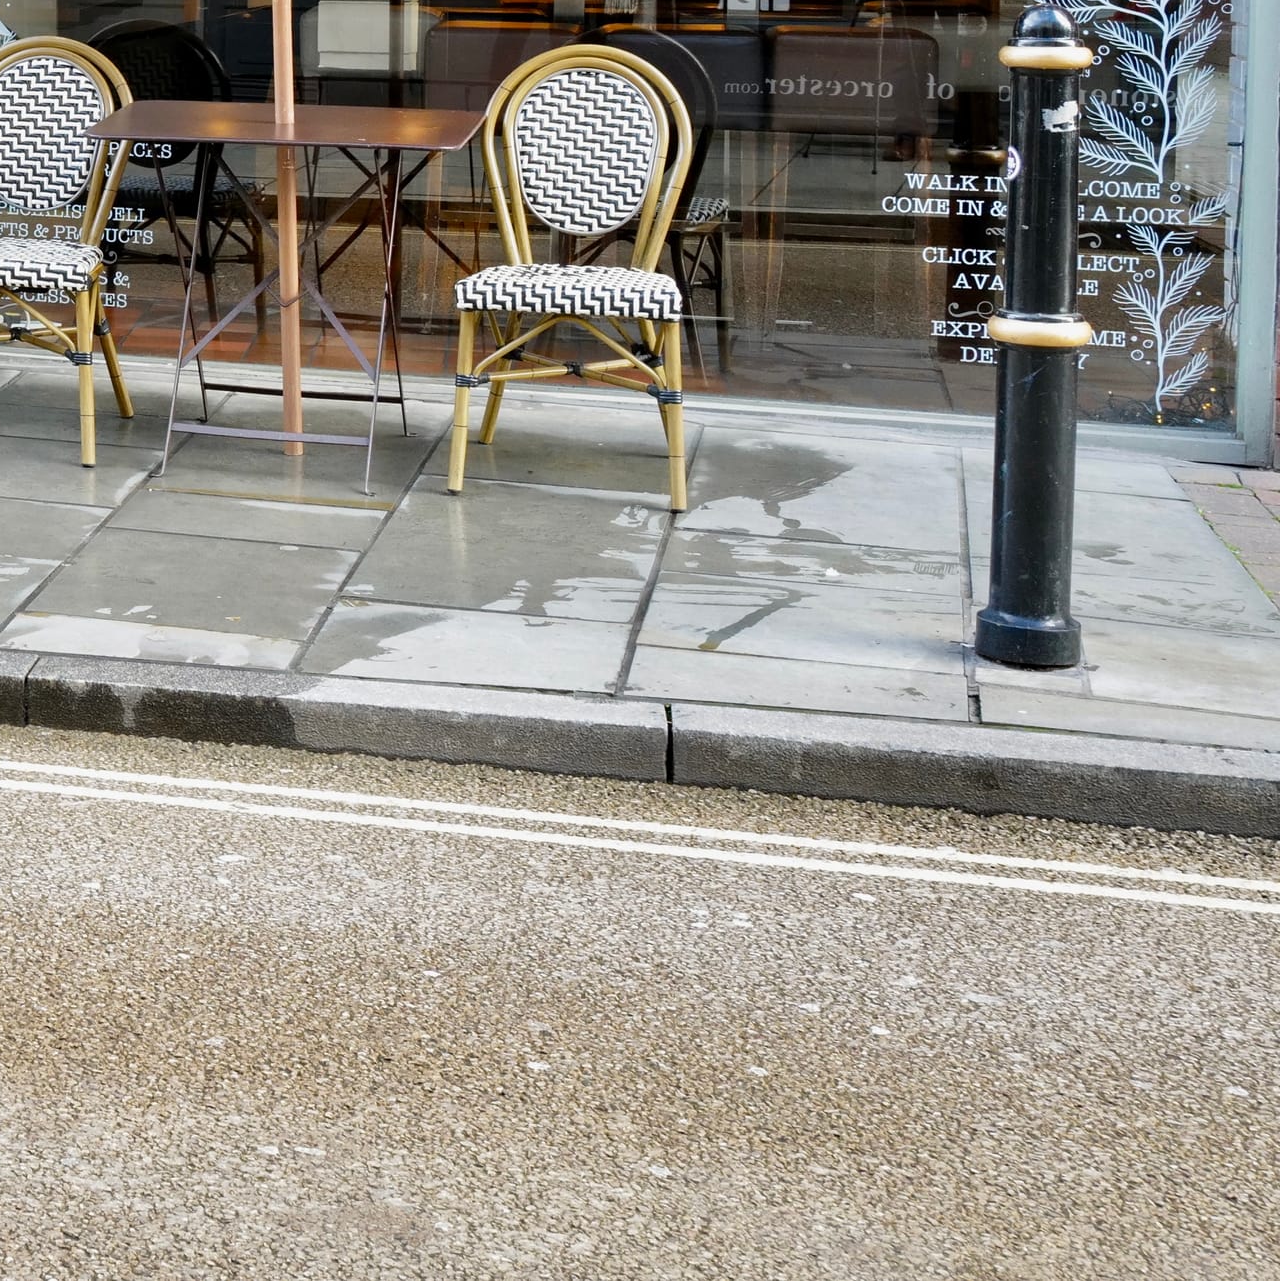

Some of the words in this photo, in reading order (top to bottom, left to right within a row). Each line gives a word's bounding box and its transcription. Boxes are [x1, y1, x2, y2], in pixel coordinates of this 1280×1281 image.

[904, 173, 979, 193] WALK
[882, 196, 950, 215] COME
[956, 199, 983, 216] IN
[1092, 206, 1110, 222] A
[1114, 206, 1185, 226] LOOK
[33, 223, 49, 238] &
[922, 247, 996, 266] CLICK
